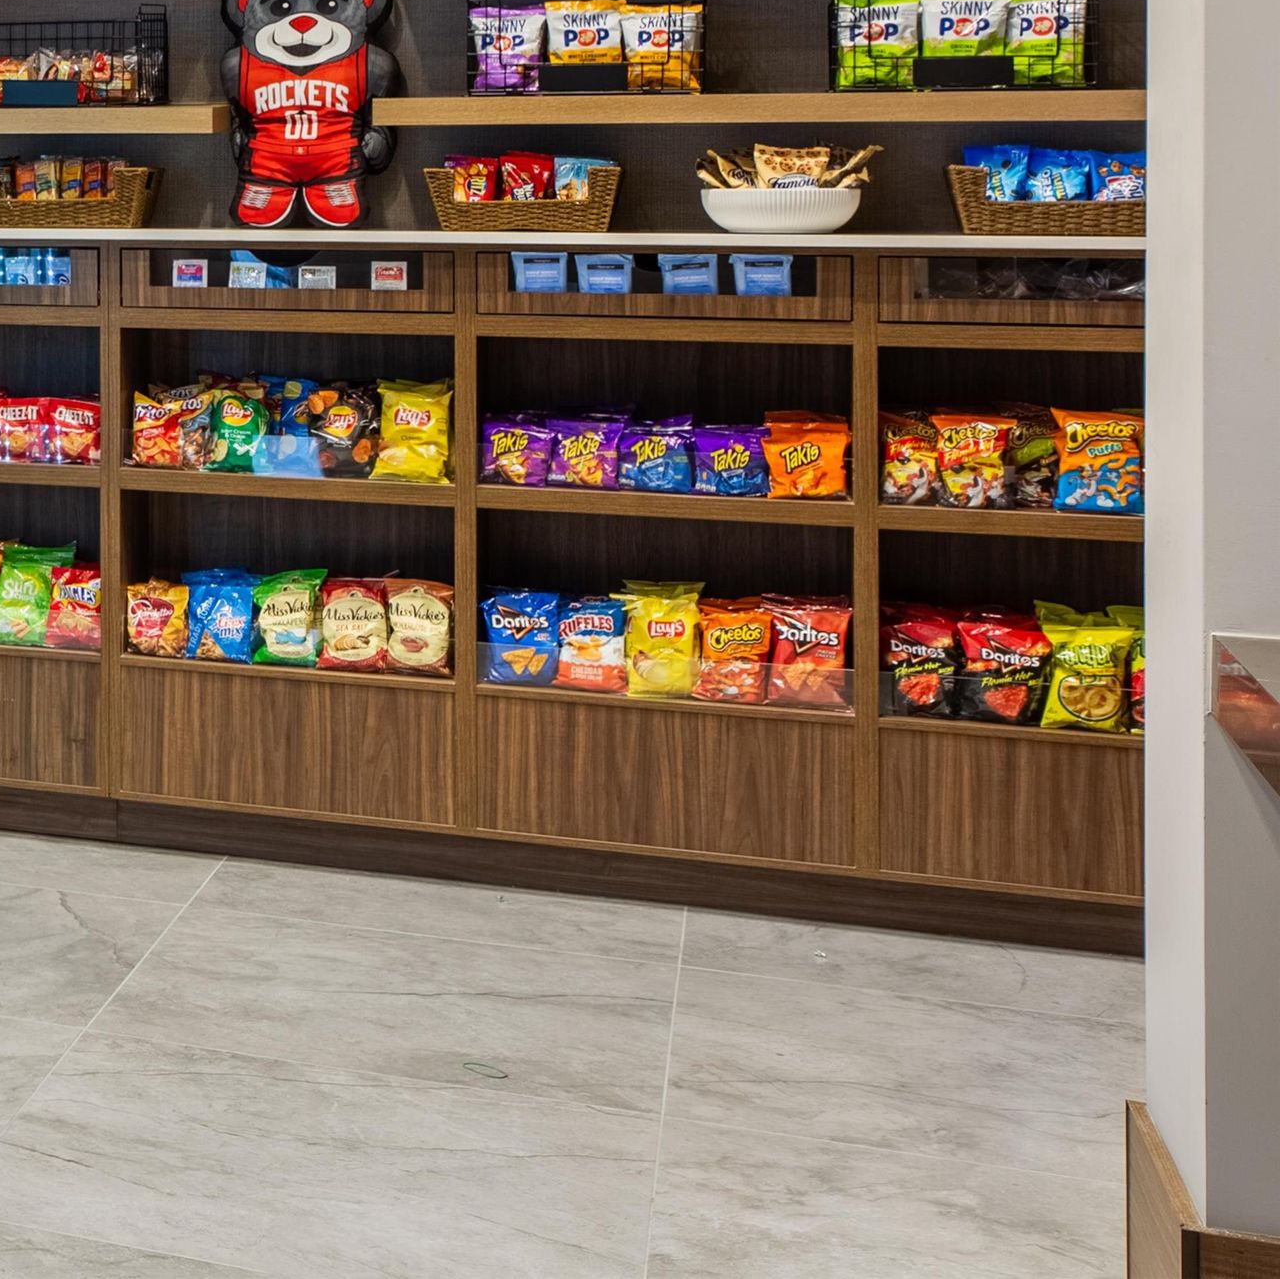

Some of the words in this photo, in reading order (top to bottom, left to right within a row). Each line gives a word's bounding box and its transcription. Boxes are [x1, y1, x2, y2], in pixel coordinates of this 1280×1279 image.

[849, 6, 900, 22] SKINNY
[940, 0, 993, 16] SKINNY
[1016, 0, 1069, 17] SKINNY
[481, 18, 527, 32] SKINNY
[563, 13, 609, 27] SKINNY
[640, 15, 684, 29] SKINNY
[939, 17, 990, 37] POP
[1019, 15, 1070, 37] POP
[563, 28, 610, 47] POP
[637, 30, 684, 49] POP
[849, 23, 899, 41] POP
[481, 34, 525, 52] POP
[253, 79, 350, 115] ROCKETS
[284, 110, 319, 140] 00
[471, 175, 486, 196] RITZ
[490, 431, 529, 457] Takis
[942, 423, 999, 449] Cheetos
[1065, 421, 1138, 452] Cheetos
[562, 433, 600, 461] Takis
[632, 436, 667, 464] Takis
[1088, 442, 1124, 457] Puffs
[710, 445, 750, 473] Takis
[782, 443, 820, 474] Takis
[1, 579, 36, 600] Sun
[263, 603, 288, 617] Miss
[324, 607, 350, 621] Miss
[349, 605, 386, 621] Vickie's
[411, 604, 446, 622] Vickie's
[219, 625, 242, 638] mix
[352, 623, 370, 631] SALT
[492, 614, 550, 630] Doritos
[559, 615, 614, 638] RUFFLES
[650, 619, 684, 638] Lay's
[709, 624, 763, 650] Cheetos
[890, 640, 946, 658] Doritos
[981, 648, 1040, 667] Doritos
[924, 661, 942, 671] Hot
[1014, 671, 1035, 681] Hot
